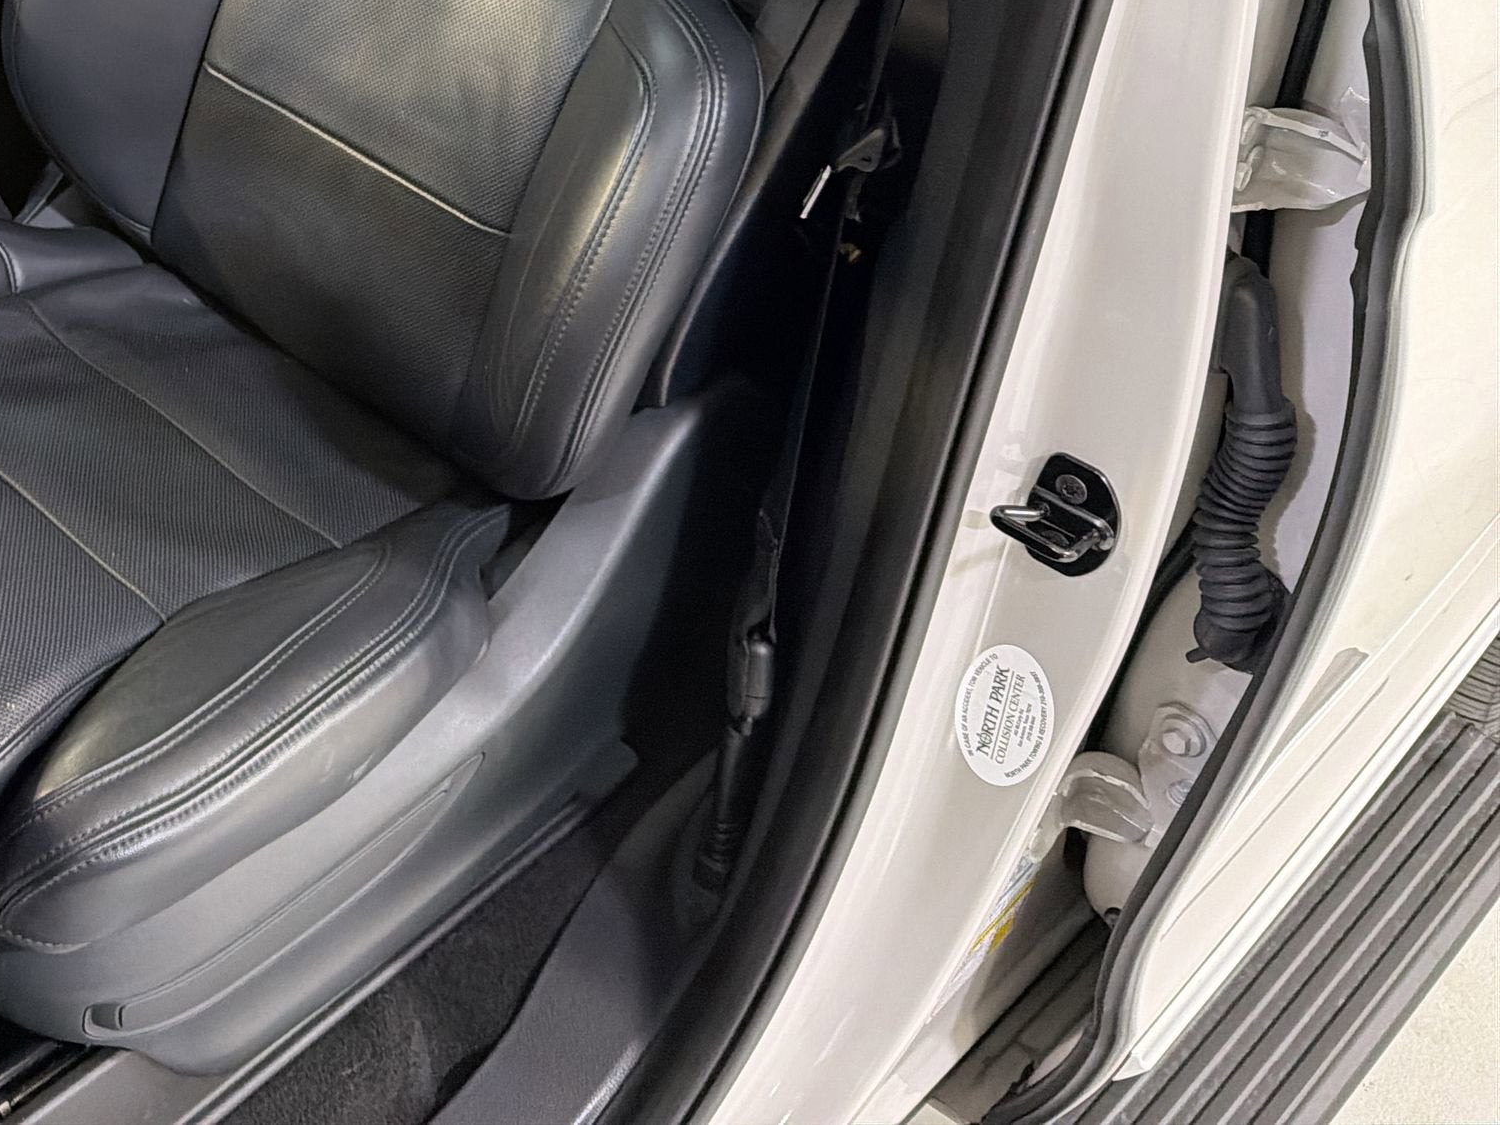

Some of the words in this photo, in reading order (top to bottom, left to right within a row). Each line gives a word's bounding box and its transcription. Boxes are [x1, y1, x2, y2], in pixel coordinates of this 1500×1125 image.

[989, 653, 999, 661] TO
[975, 704, 1001, 757] NORTH
[989, 664, 1011, 705] PARK
[995, 711, 1016, 765] COLLISION
[1008, 673, 1026, 713] CENTER
[1019, 757, 1033, 773] PARK
